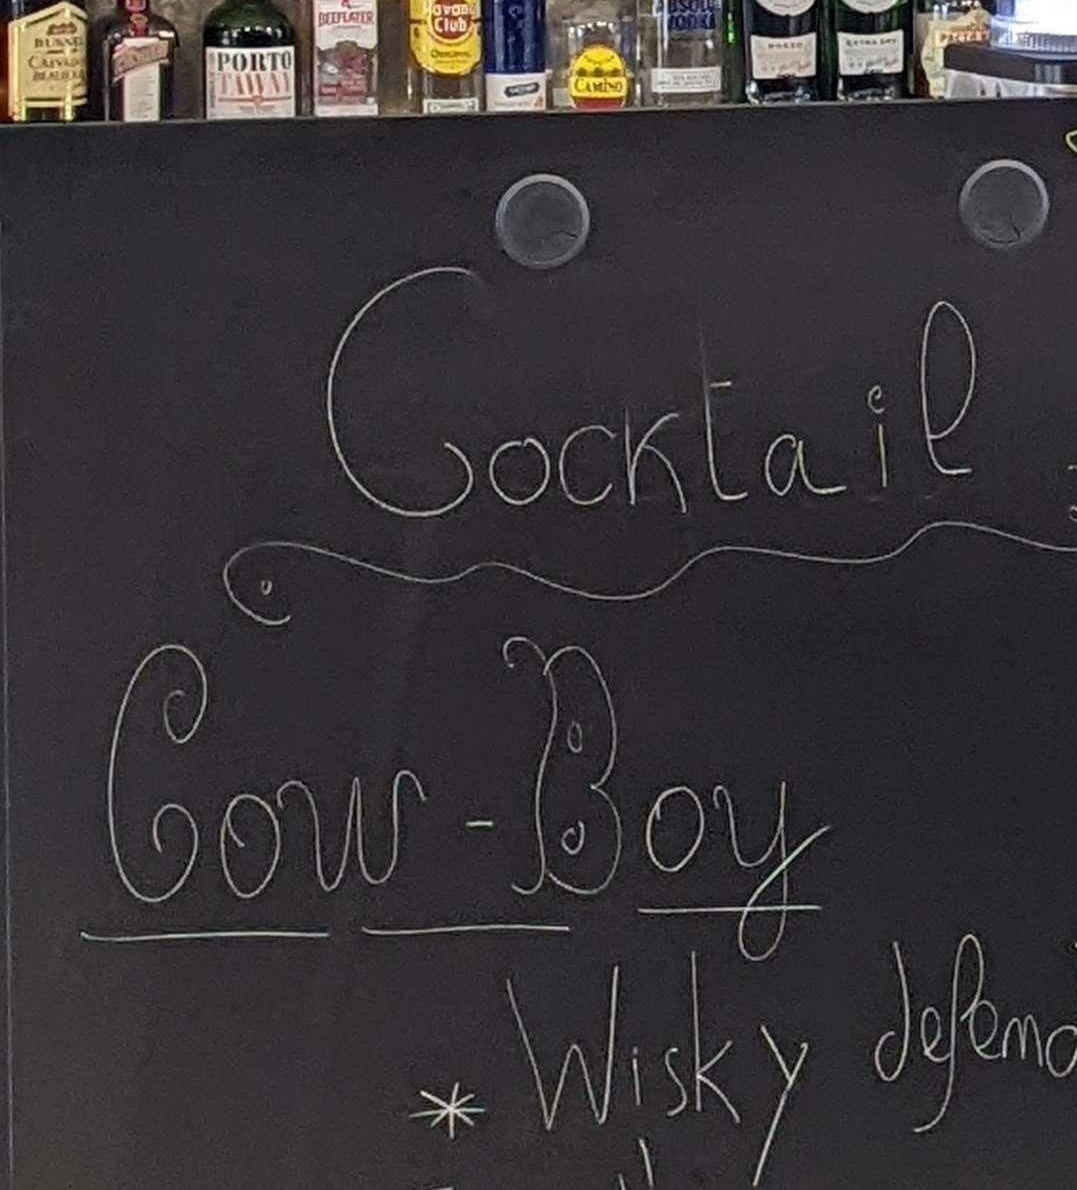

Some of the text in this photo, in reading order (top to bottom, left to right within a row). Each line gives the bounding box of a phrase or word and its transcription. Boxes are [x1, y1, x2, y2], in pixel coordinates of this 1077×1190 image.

[317, 11, 375, 28] BEEFEATER
[434, 17, 467, 33] Club
[217, 51, 292, 72] PORTO
[327, 266, 977, 518] Cocktail
[506, 950, 810, 1187] Wisky
